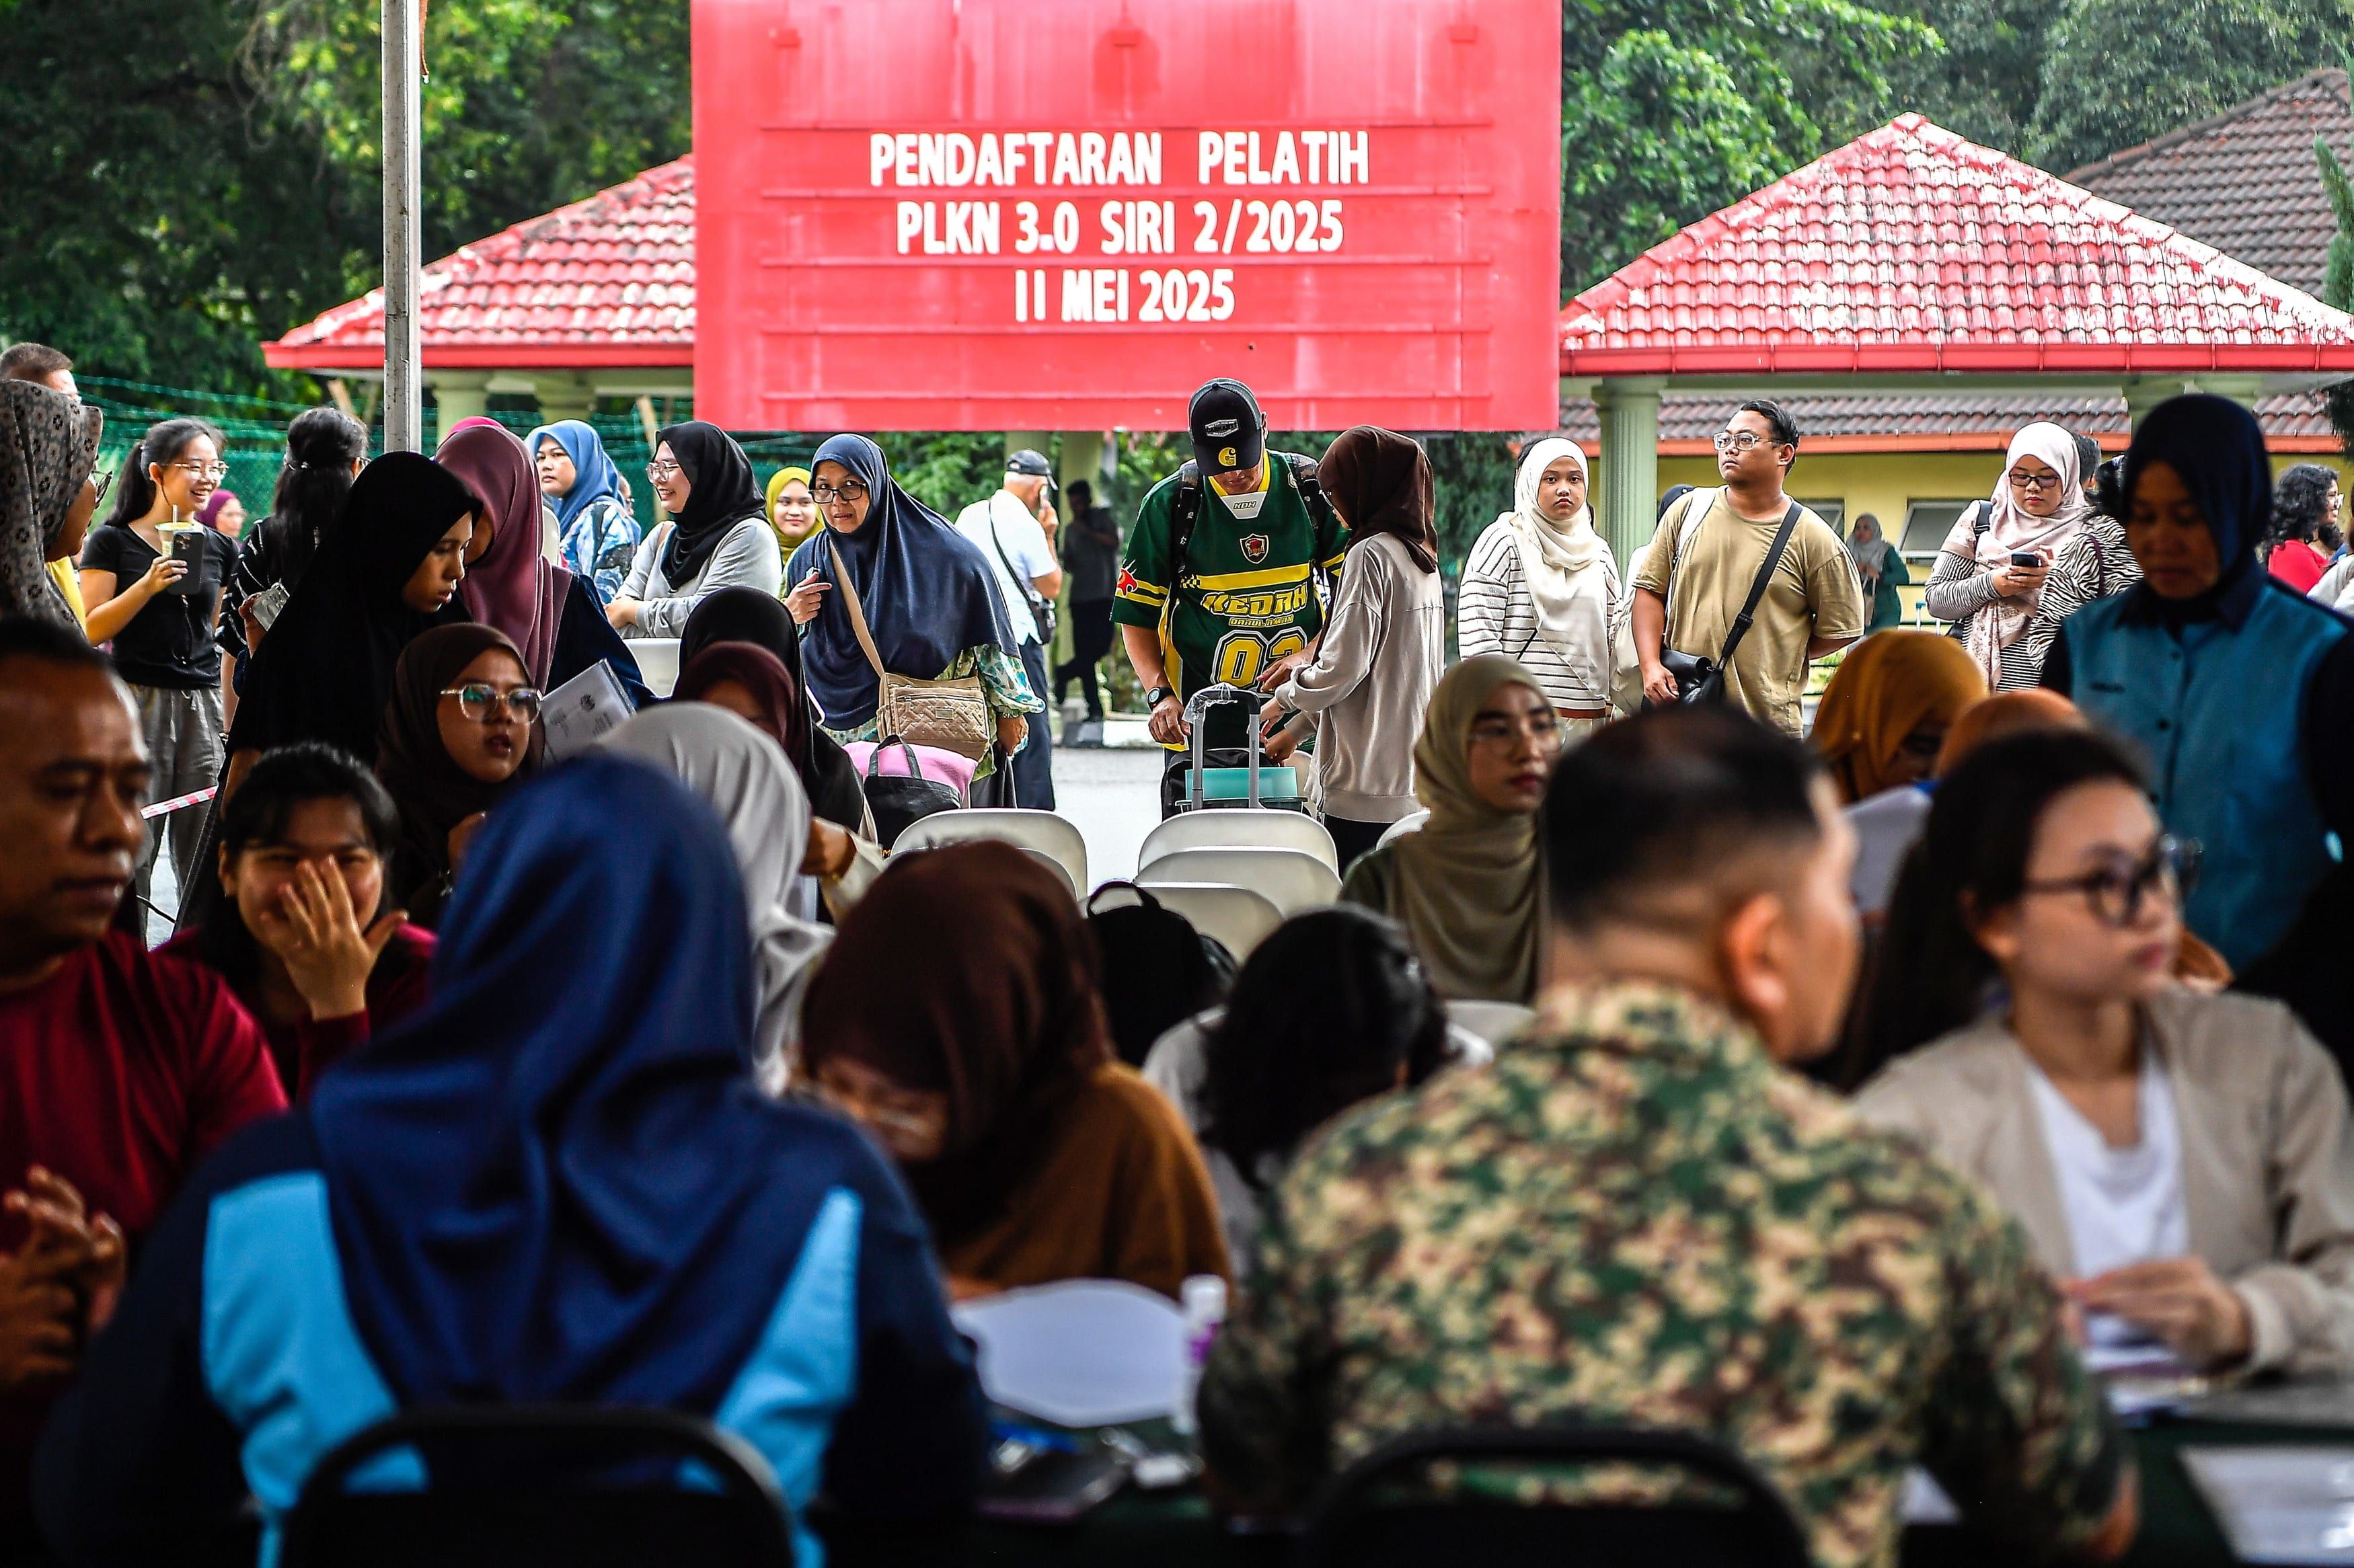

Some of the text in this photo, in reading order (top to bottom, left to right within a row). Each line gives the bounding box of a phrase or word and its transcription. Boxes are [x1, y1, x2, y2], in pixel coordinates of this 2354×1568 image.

[870, 130, 1369, 186] PENDAFTARAN PELATIH
[897, 198, 1344, 254] PLKN 3.0 SIRI 2/2025
[1061, 269, 1129, 322] MEI
[1138, 268, 1236, 321] 2025
[1201, 583, 1307, 617] KEDAH
[1229, 615, 1293, 627] DARUL AMAN
